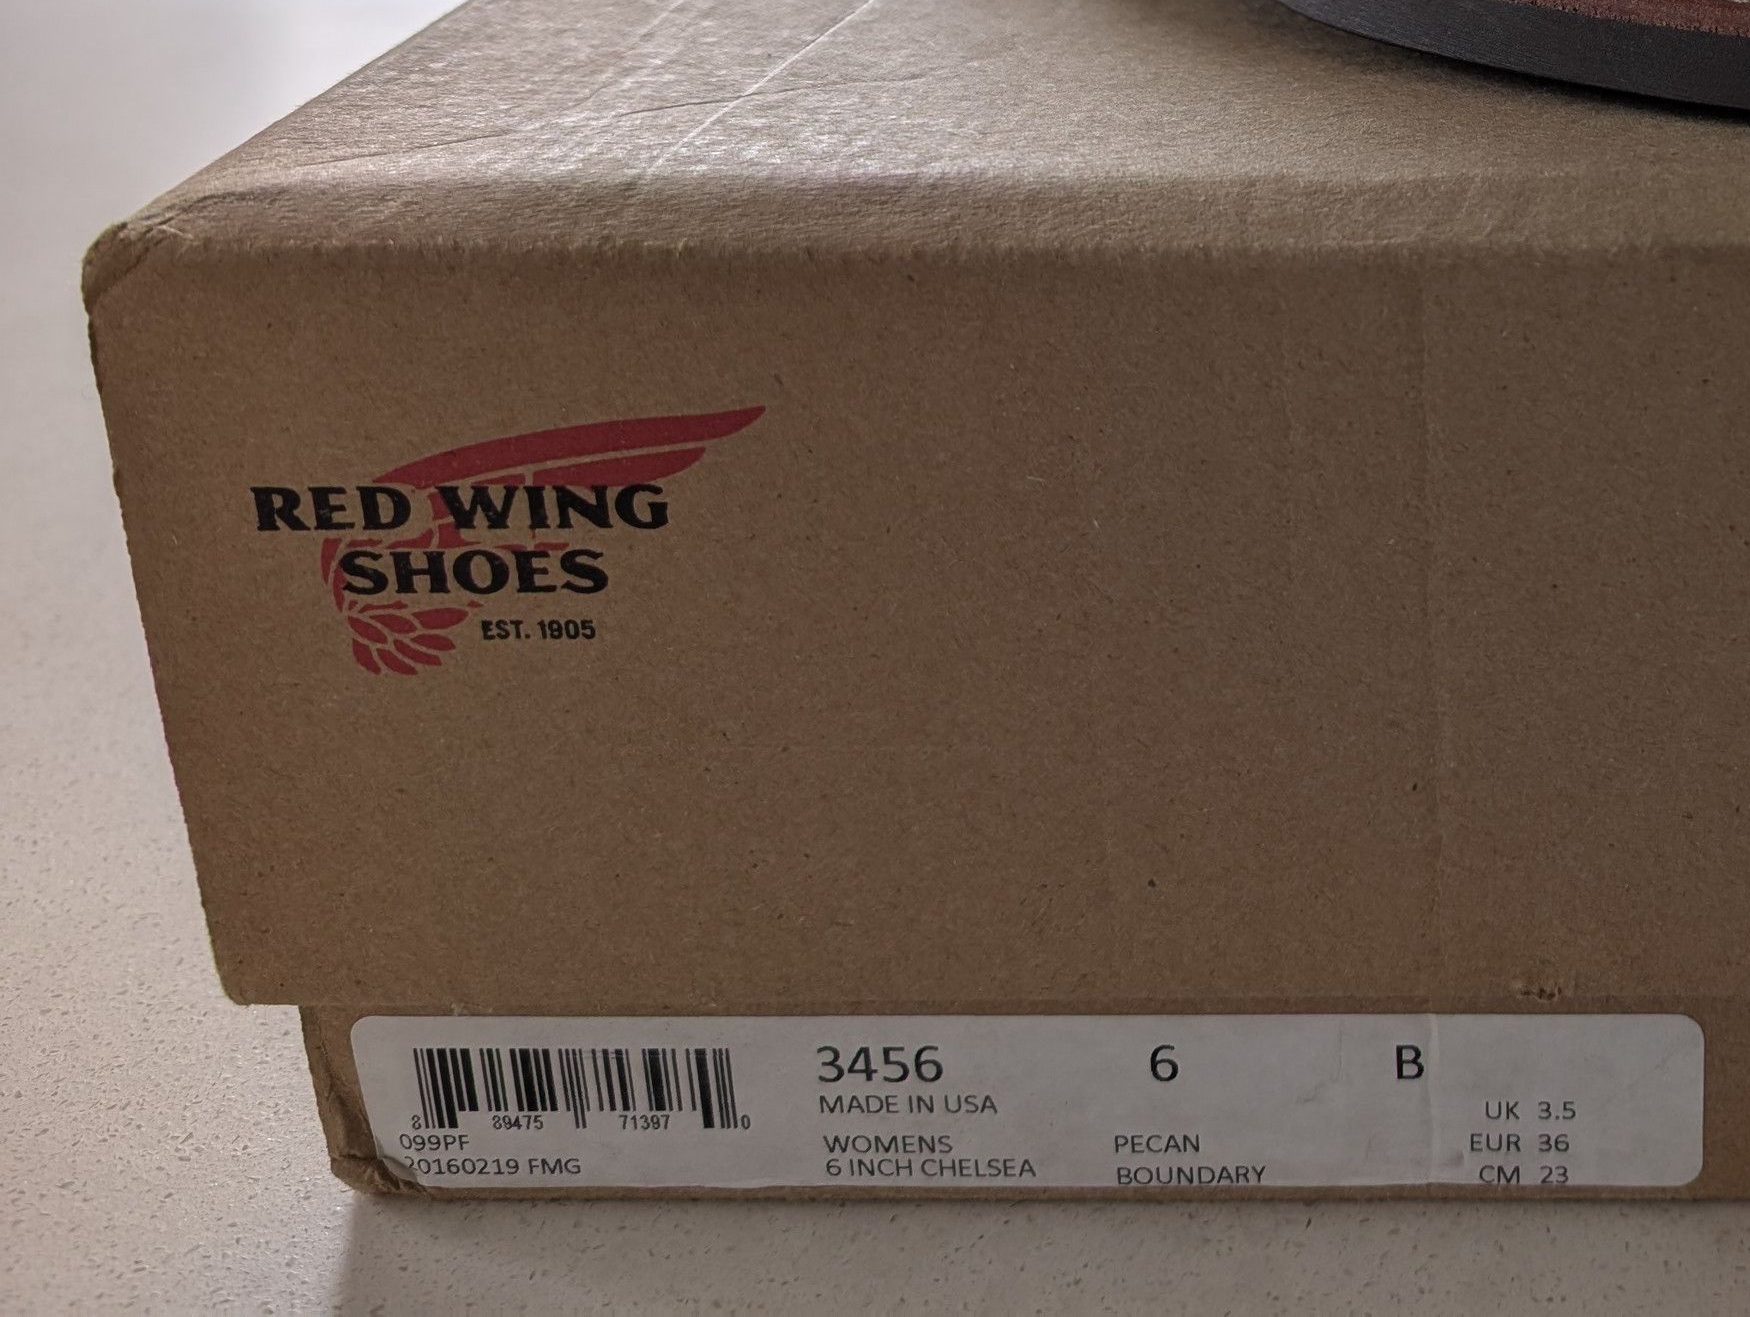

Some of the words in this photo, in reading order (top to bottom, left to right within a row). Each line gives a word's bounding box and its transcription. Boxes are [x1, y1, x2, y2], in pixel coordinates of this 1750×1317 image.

[250, 485, 412, 531] RED
[434, 484, 670, 530] WING
[340, 549, 609, 595] SHOES
[482, 620, 531, 640] EST.
[537, 619, 597, 640] 1905
[816, 1045, 944, 1083] 3456
[1149, 1044, 1180, 1082] 6
[1395, 1044, 1426, 1081] B
[819, 1095, 901, 1114] MADE
[908, 1095, 934, 1114] IN
[943, 1095, 998, 1114] USA
[1485, 1100, 1520, 1120] UK
[1537, 1100, 1577, 1120] 3.5
[491, 1115, 544, 1131] 89475
[619, 1115, 671, 1130] 71397
[741, 1115, 752, 1130] 0
[399, 1133, 471, 1152] 099PF
[823, 1134, 953, 1155] WOMENS
[1114, 1135, 1201, 1154] PECAN
[1469, 1133, 1522, 1153] EUR
[1537, 1133, 1571, 1153] 36
[528, 1157, 581, 1175] FMG
[825, 1158, 841, 1177] 6
[849, 1158, 914, 1177] INCH
[920, 1158, 1037, 1178] CHELSEA
[1116, 1165, 1266, 1185] BOUNDARY
[1478, 1165, 1522, 1184] CM
[1539, 1166, 1570, 1184] 23
